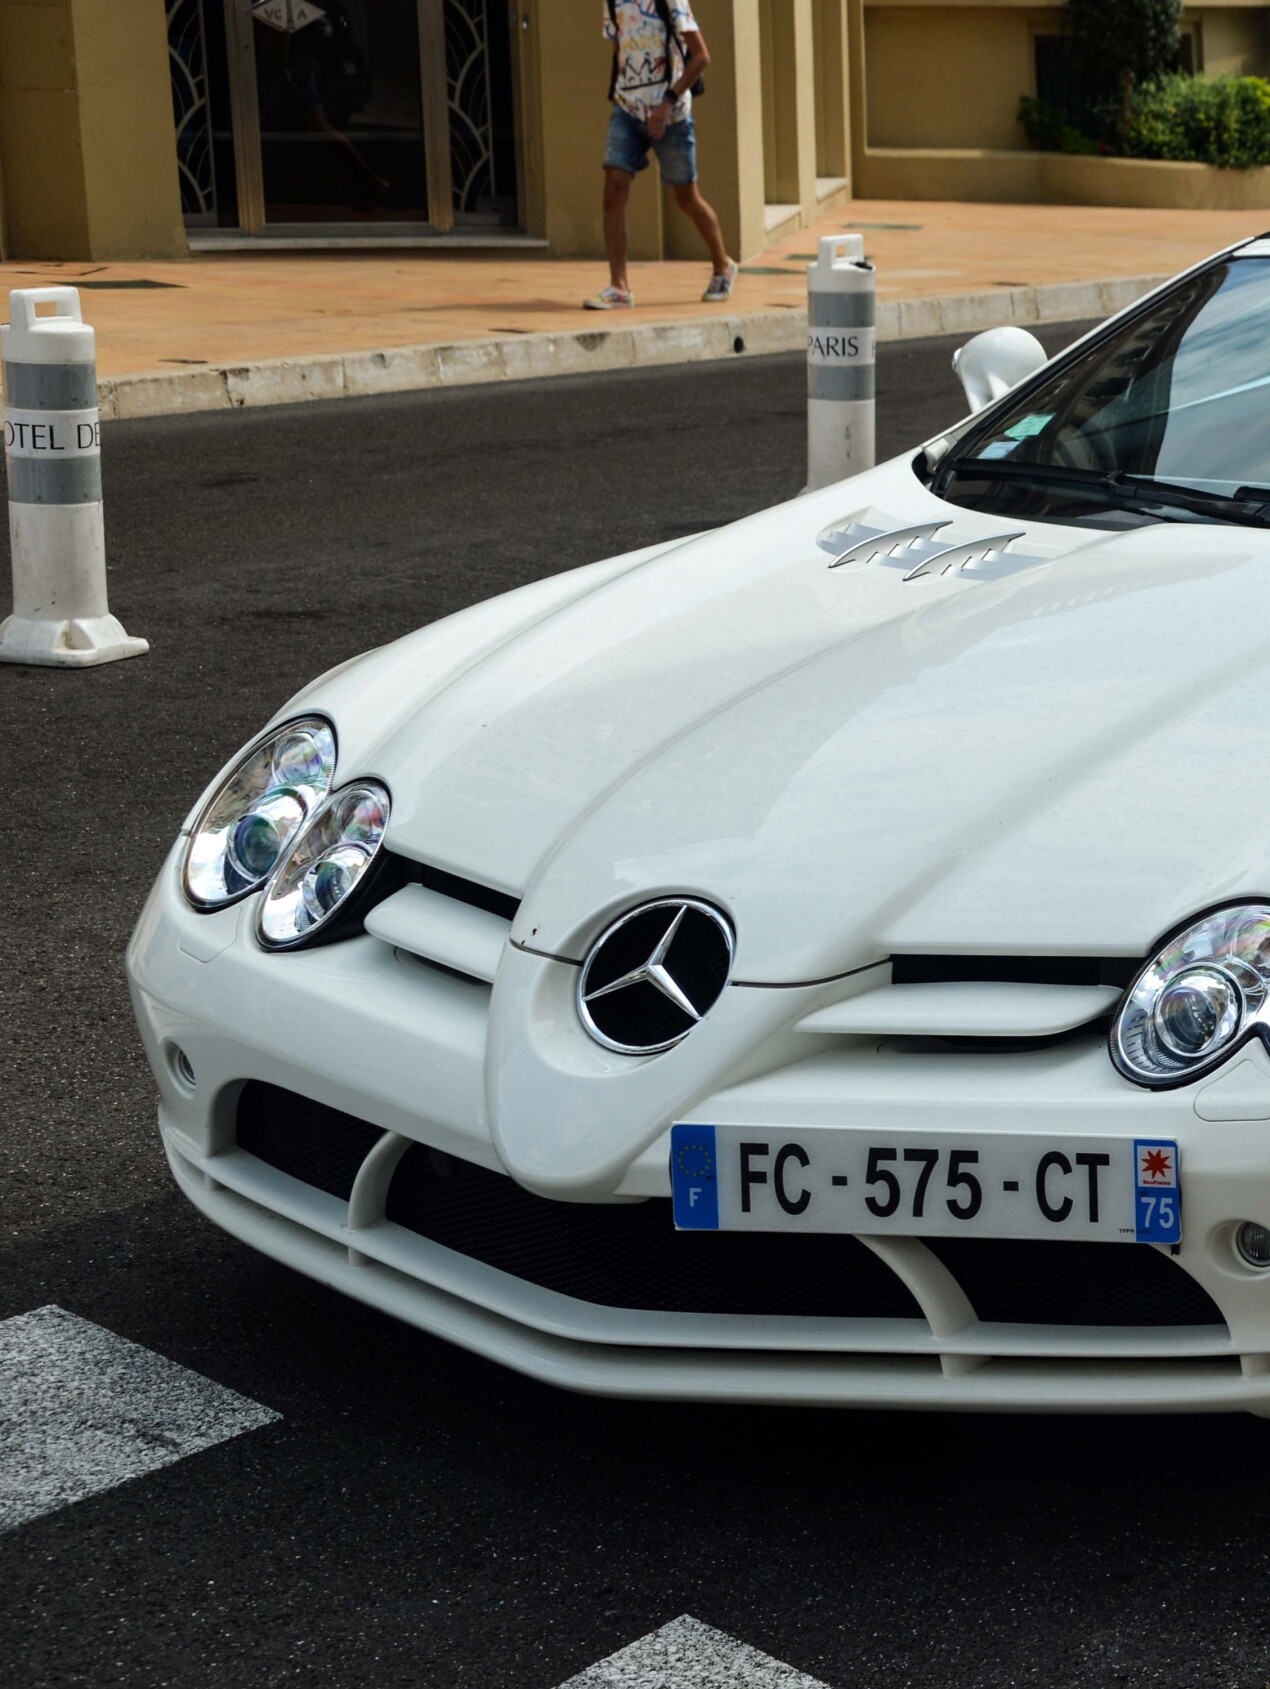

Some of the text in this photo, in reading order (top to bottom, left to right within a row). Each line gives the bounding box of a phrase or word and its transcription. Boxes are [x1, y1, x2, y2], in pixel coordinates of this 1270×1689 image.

[807, 335, 859, 358] PARIS
[689, 1187, 702, 1208] F
[1140, 1196, 1175, 1229] 75
